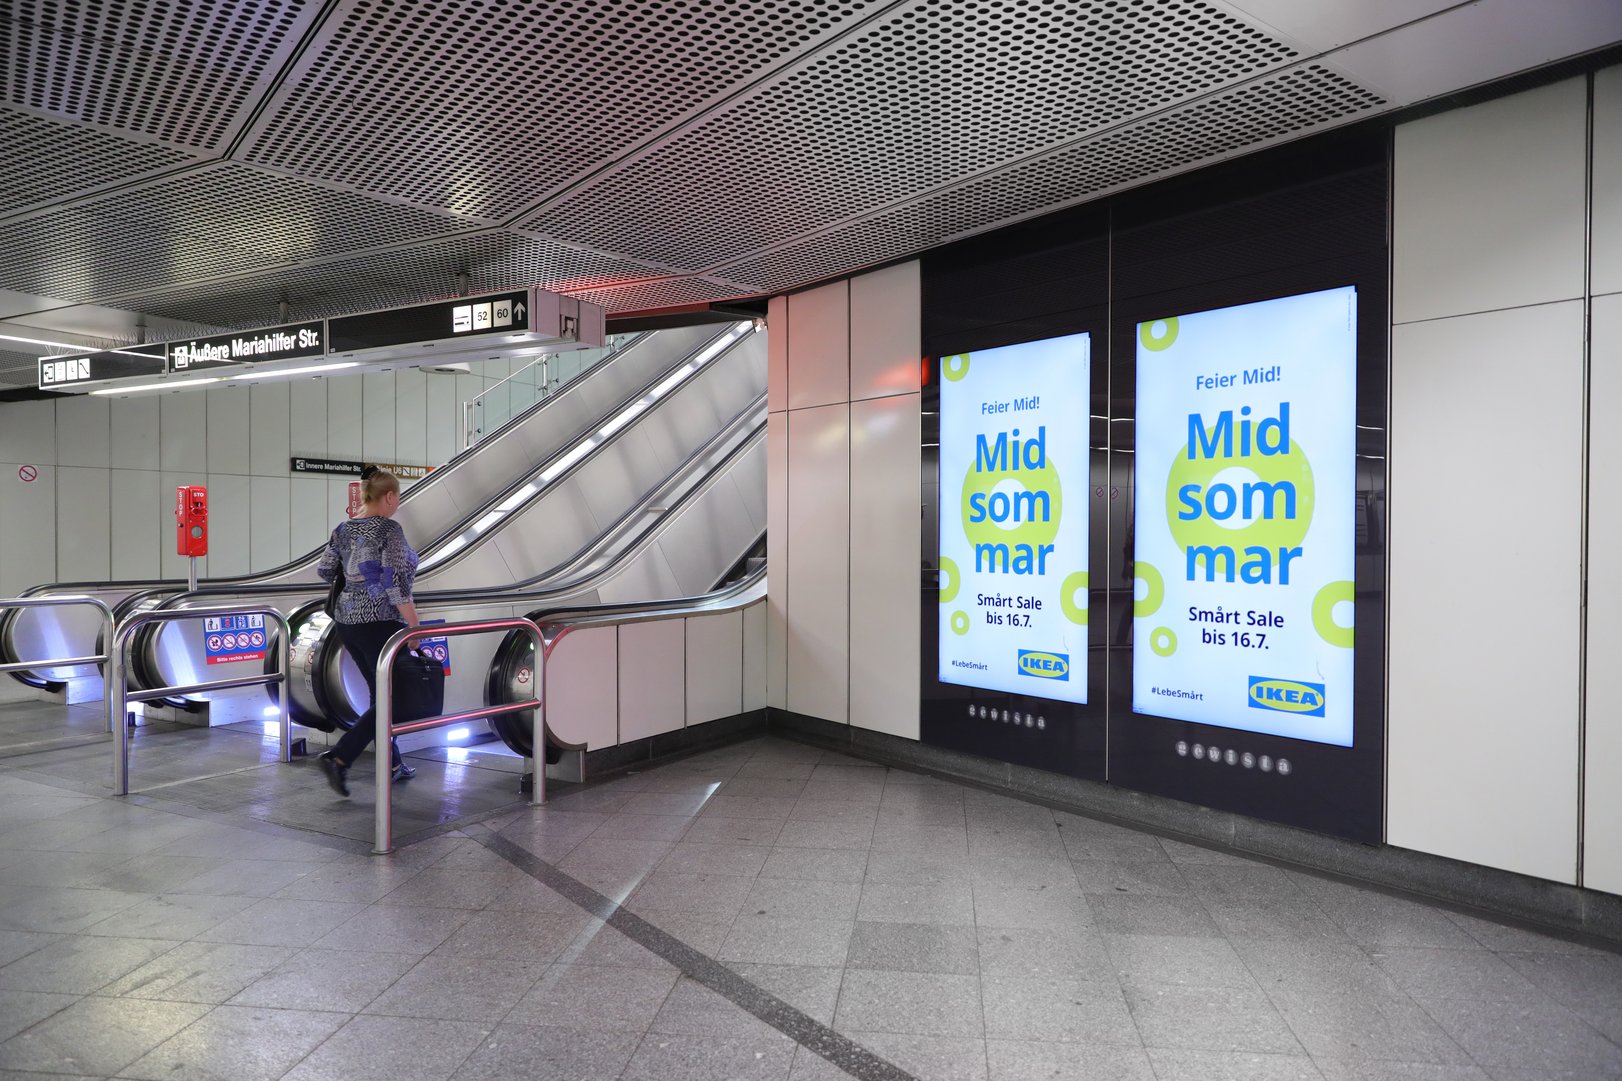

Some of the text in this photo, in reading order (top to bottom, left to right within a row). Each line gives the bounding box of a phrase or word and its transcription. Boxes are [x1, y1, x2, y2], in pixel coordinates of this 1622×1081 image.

[477, 308, 509, 321] 52 60
[189, 329, 320, 362] Äußere Mariahilfer Str.
[1196, 366, 1281, 390] Feier Mid!
[981, 396, 1040, 415] Feier Mid!
[1187, 401, 1290, 461] Mid
[976, 425, 1046, 473] Mid
[305, 462, 324, 470] Innere
[324, 463, 353, 472] Mariahilfer
[969, 490, 1050, 523] som
[1178, 480, 1296, 521] som
[975, 543, 1055, 576] mar
[1186, 545, 1303, 585] mar
[977, 592, 1042, 610] Smårt Sale
[986, 611, 1032, 628] bis 16.7.
[1188, 605, 1285, 628] Smårt Sale
[1202, 628, 1269, 650] bis 16.7.
[951, 660, 988, 671] #LebeSmårt
[1022, 657, 1065, 673] IKEA
[1151, 686, 1204, 701] #LebeSmårt
[1255, 686, 1319, 707] IKEA
